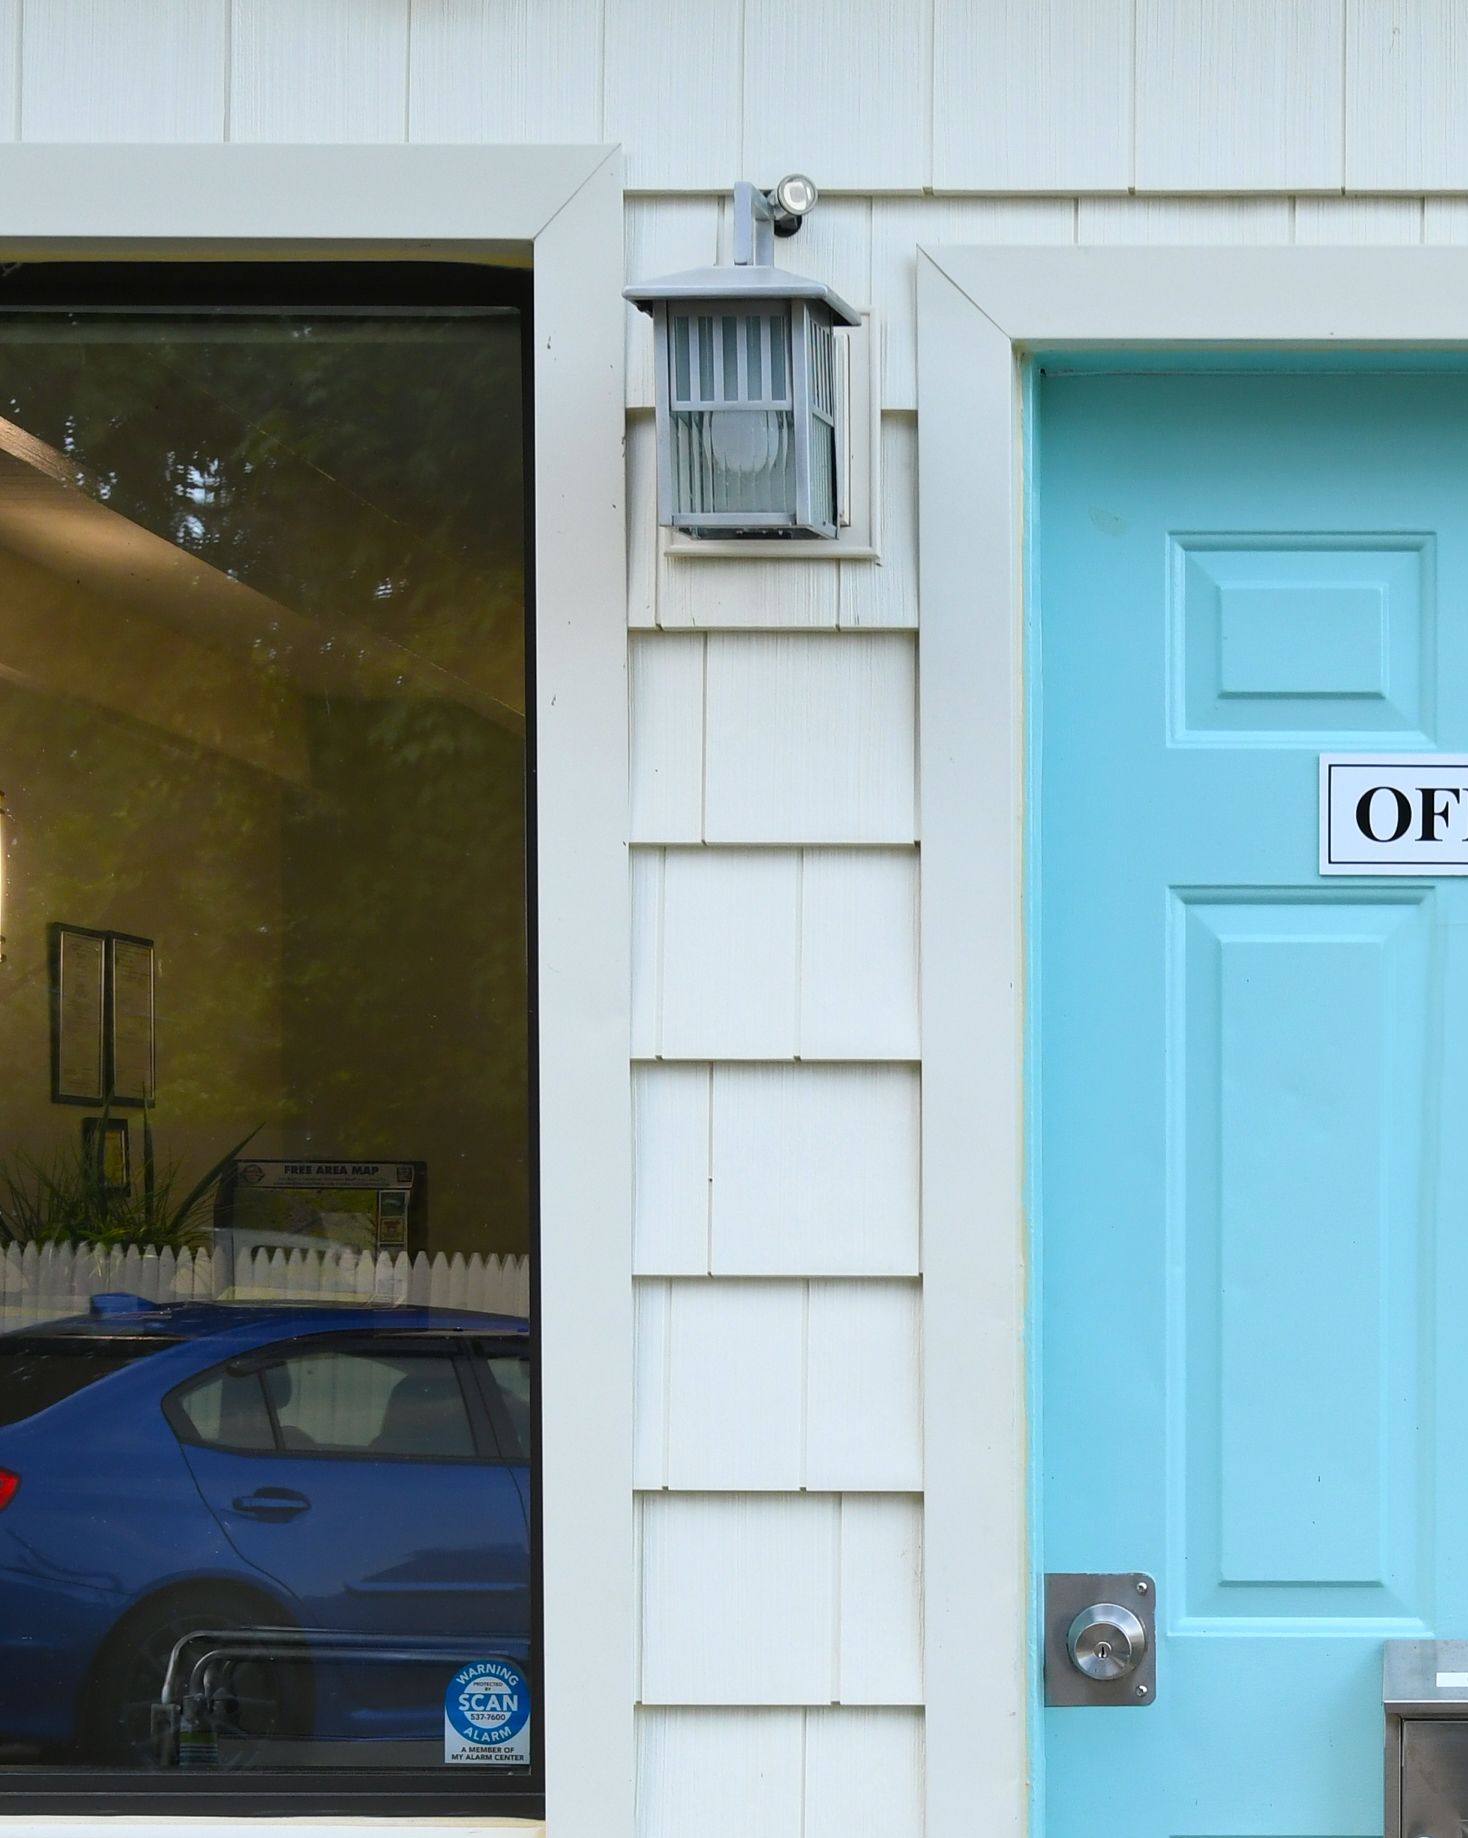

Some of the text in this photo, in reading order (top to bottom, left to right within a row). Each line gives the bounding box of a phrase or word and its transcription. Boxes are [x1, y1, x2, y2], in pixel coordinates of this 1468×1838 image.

[284, 1165, 379, 1175] FREE AREA MAP
[455, 1663, 519, 1686] WARNING
[458, 1694, 518, 1711] SCAN
[470, 1713, 506, 1721] 537-7600
[463, 1726, 512, 1742] ALARM
